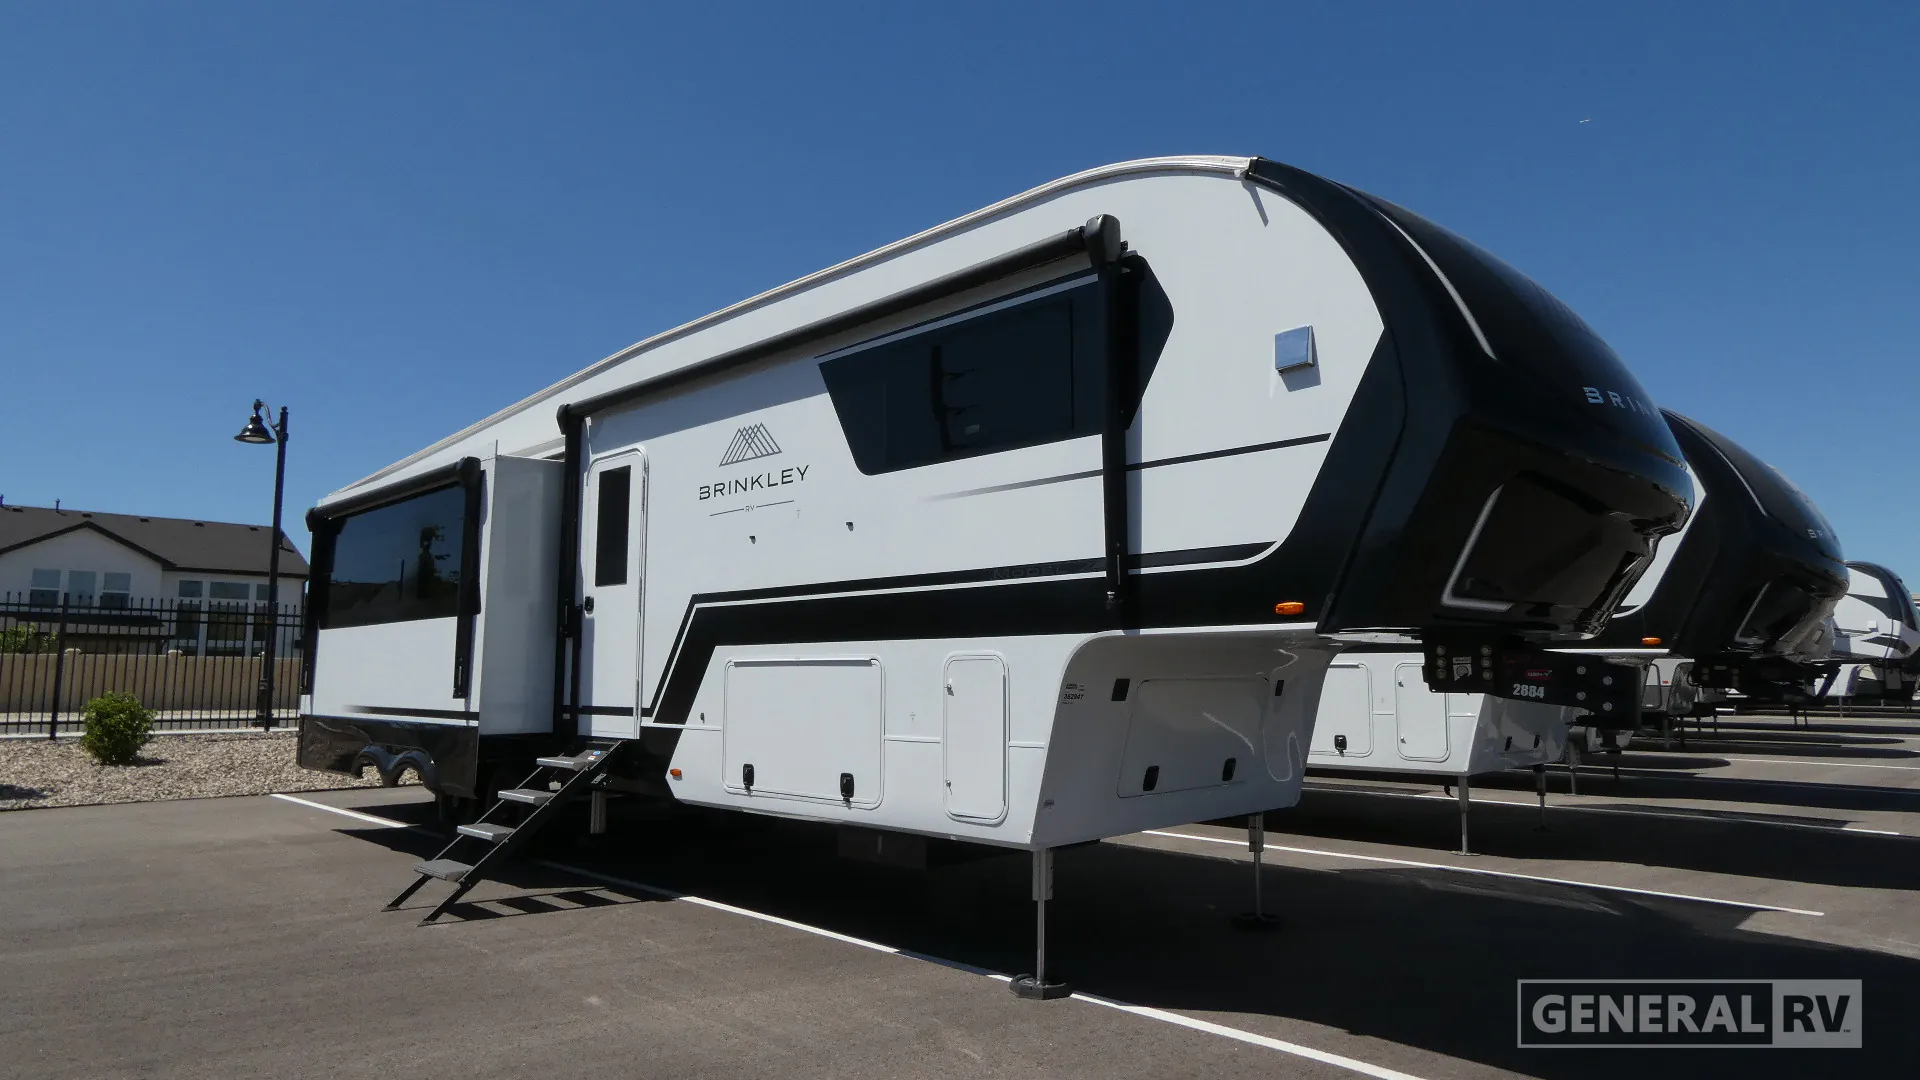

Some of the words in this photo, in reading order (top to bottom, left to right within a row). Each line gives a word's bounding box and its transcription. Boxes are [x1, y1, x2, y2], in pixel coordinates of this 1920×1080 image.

[699, 464, 809, 501] BRINKLEY
[745, 505, 755, 513] RV
[1512, 683, 1545, 699] 2884
